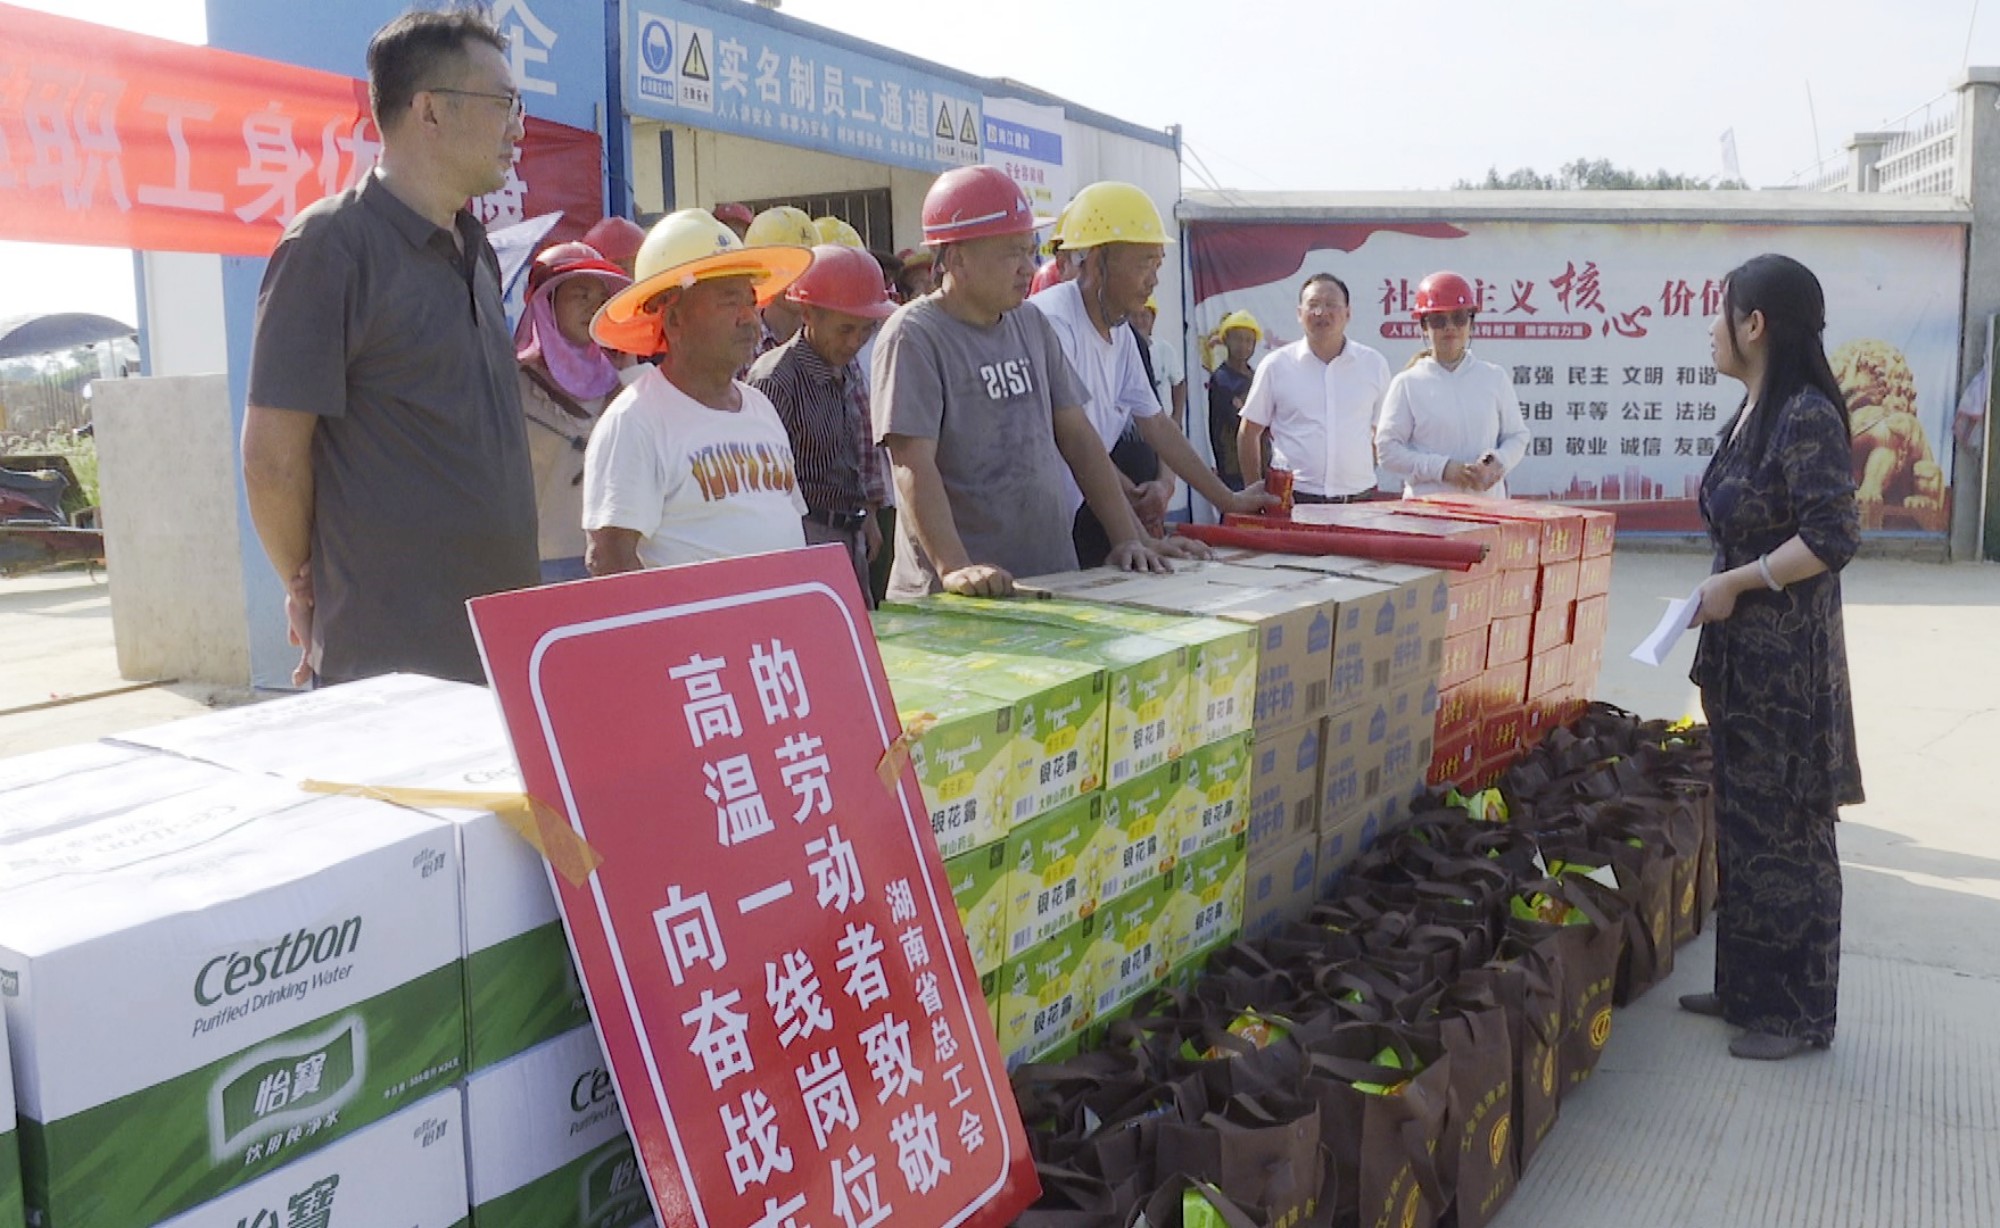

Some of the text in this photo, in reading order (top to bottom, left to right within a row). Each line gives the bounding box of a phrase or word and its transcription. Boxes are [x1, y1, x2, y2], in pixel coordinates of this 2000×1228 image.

[717, 37, 931, 138] 实名制员工通道
[1512, 366, 1718, 385] 富强 民主 文明 和谐
[1566, 401, 1608, 421] 平等
[1621, 401, 1662, 421] 公正
[1676, 401, 1716, 421] 法治
[1525, 437, 1715, 456] 国 敬业 诚信 友善
[1133, 718, 1166, 750] 银花露
[1040, 748, 1079, 786] 银花露
[931, 797, 978, 835] 银花露
[1203, 799, 1234, 828] 银花露
[1123, 834, 1157, 869] 银花露
[1037, 876, 1077, 917] 银花露
[748, 638, 952, 1196] 的劳动者致敬
[668, 653, 893, 1228] 高温一线岗位
[194, 915, 362, 1007] C'estbon
[1121, 942, 1152, 980] 银花露
[192, 963, 355, 1039] Purified Drinking Water
[884, 877, 985, 1154] 湖南省总工会
[1034, 993, 1073, 1036] 银花露
[244, 1110, 341, 1167] 饮用纯净水
